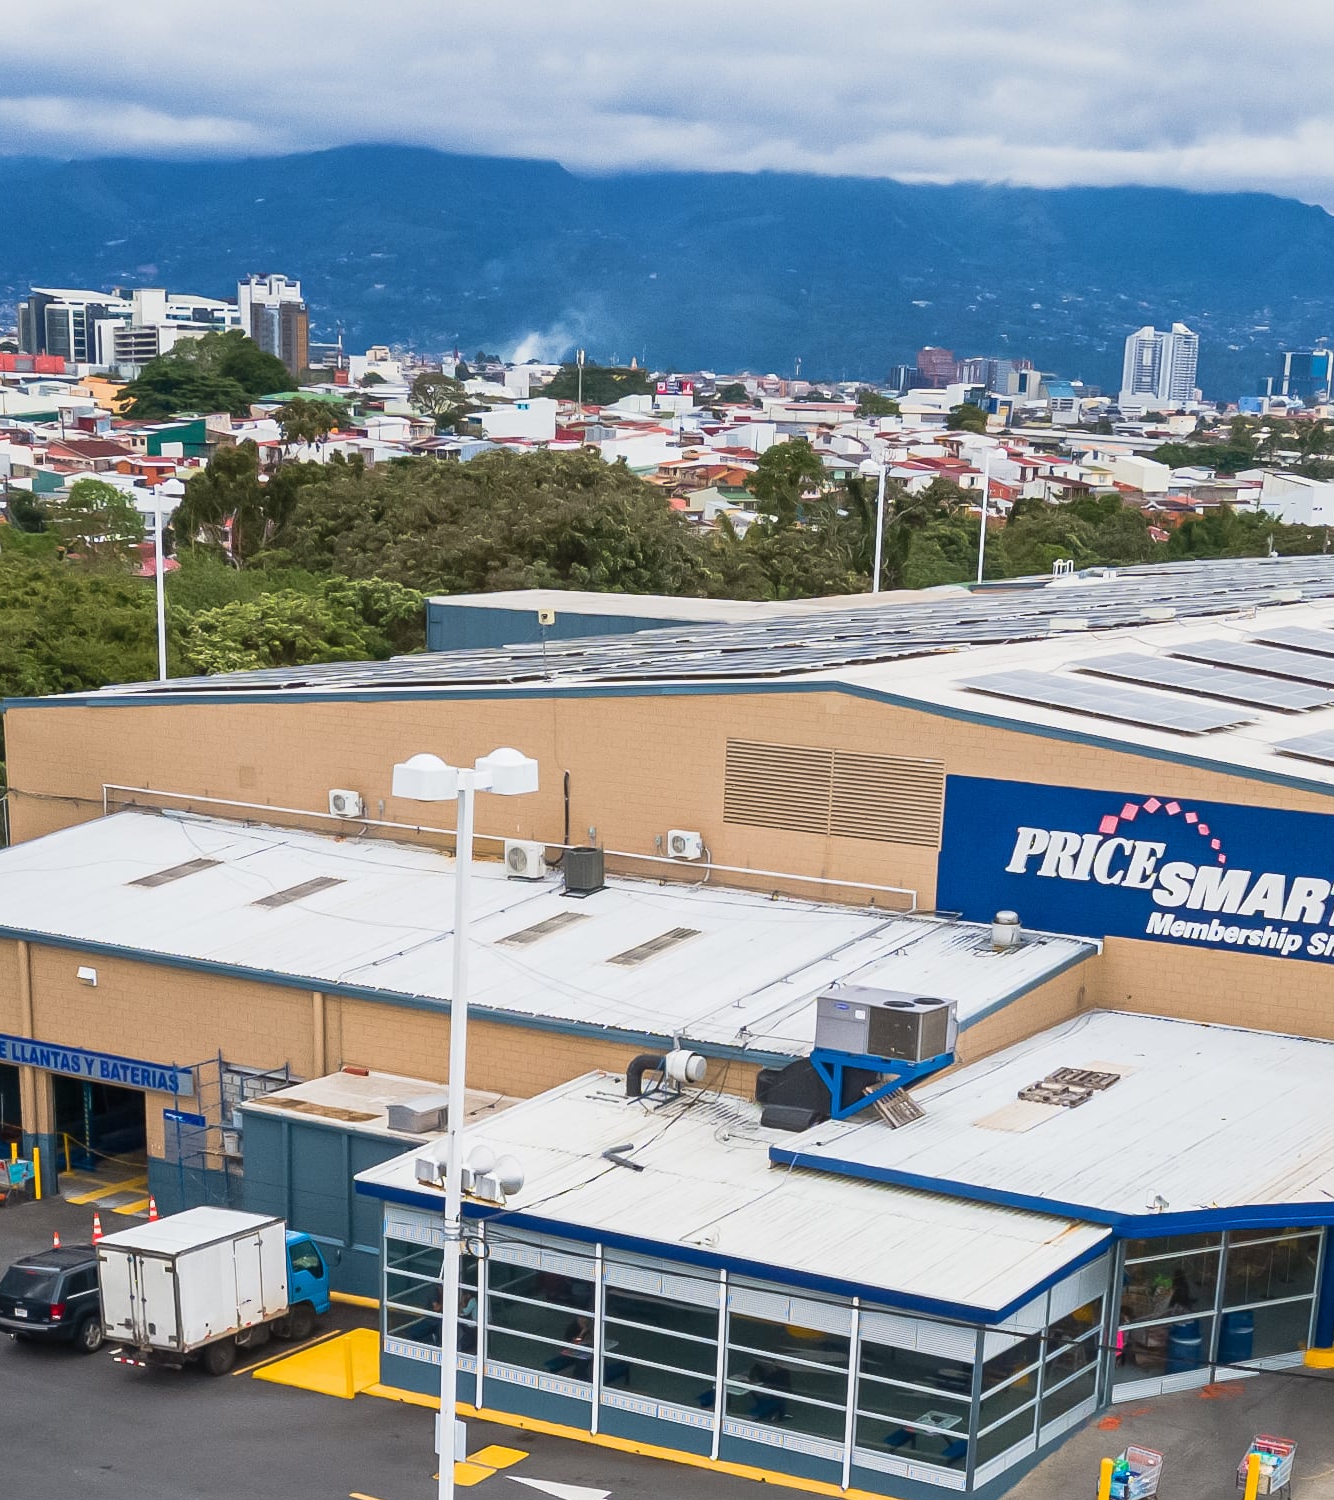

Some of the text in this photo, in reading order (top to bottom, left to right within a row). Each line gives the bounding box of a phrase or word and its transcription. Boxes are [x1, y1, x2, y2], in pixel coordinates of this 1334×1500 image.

[1145, 911, 1302, 955] Membership
[11, 1042, 81, 1073] LLANTAS
[84, 1056, 96, 1076] Y
[100, 1060, 180, 1092] BATERIAS
